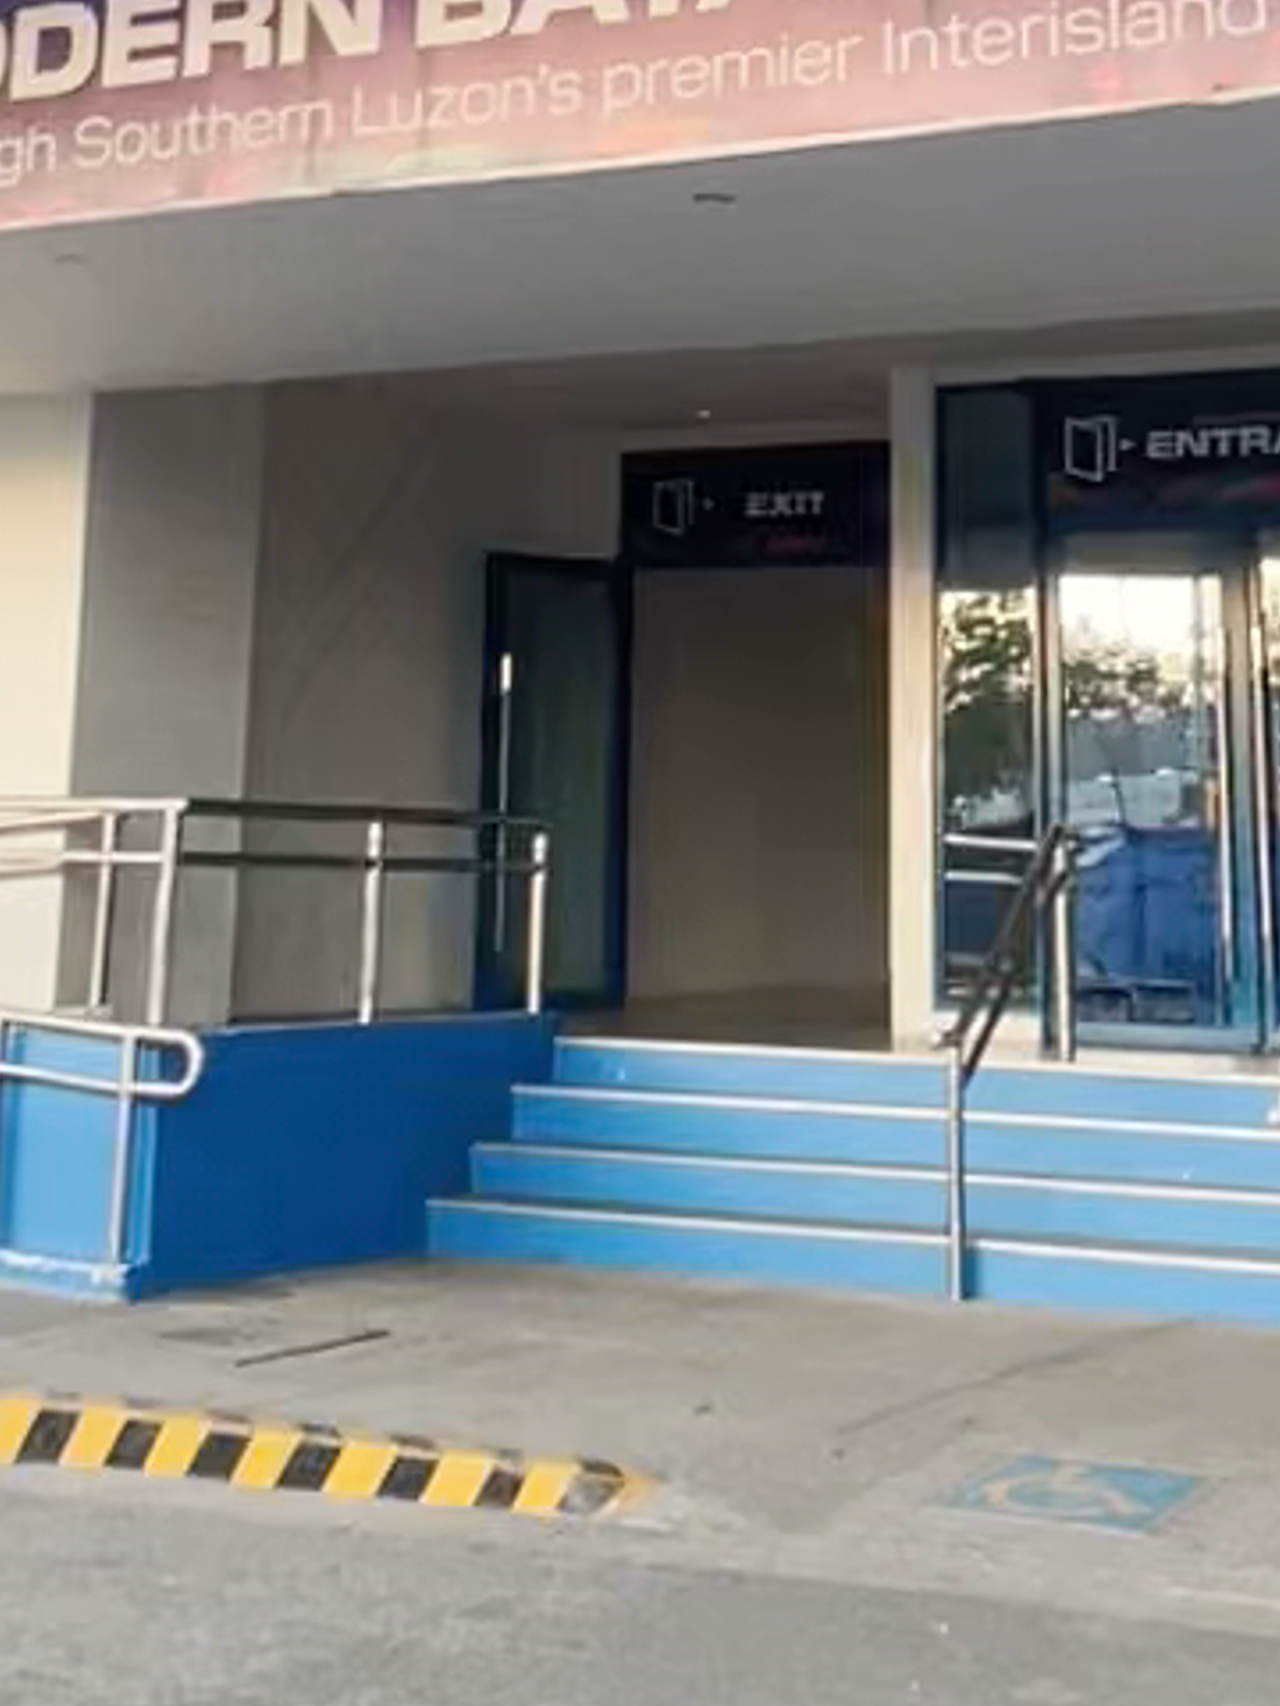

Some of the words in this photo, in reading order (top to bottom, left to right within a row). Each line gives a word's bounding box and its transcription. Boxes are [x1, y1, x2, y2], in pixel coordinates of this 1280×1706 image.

[73, 97, 334, 168] Southern
[350, 64, 582, 134] Luzon's
[600, 37, 860, 114] premier
[744, 491, 824, 517] EXIT
